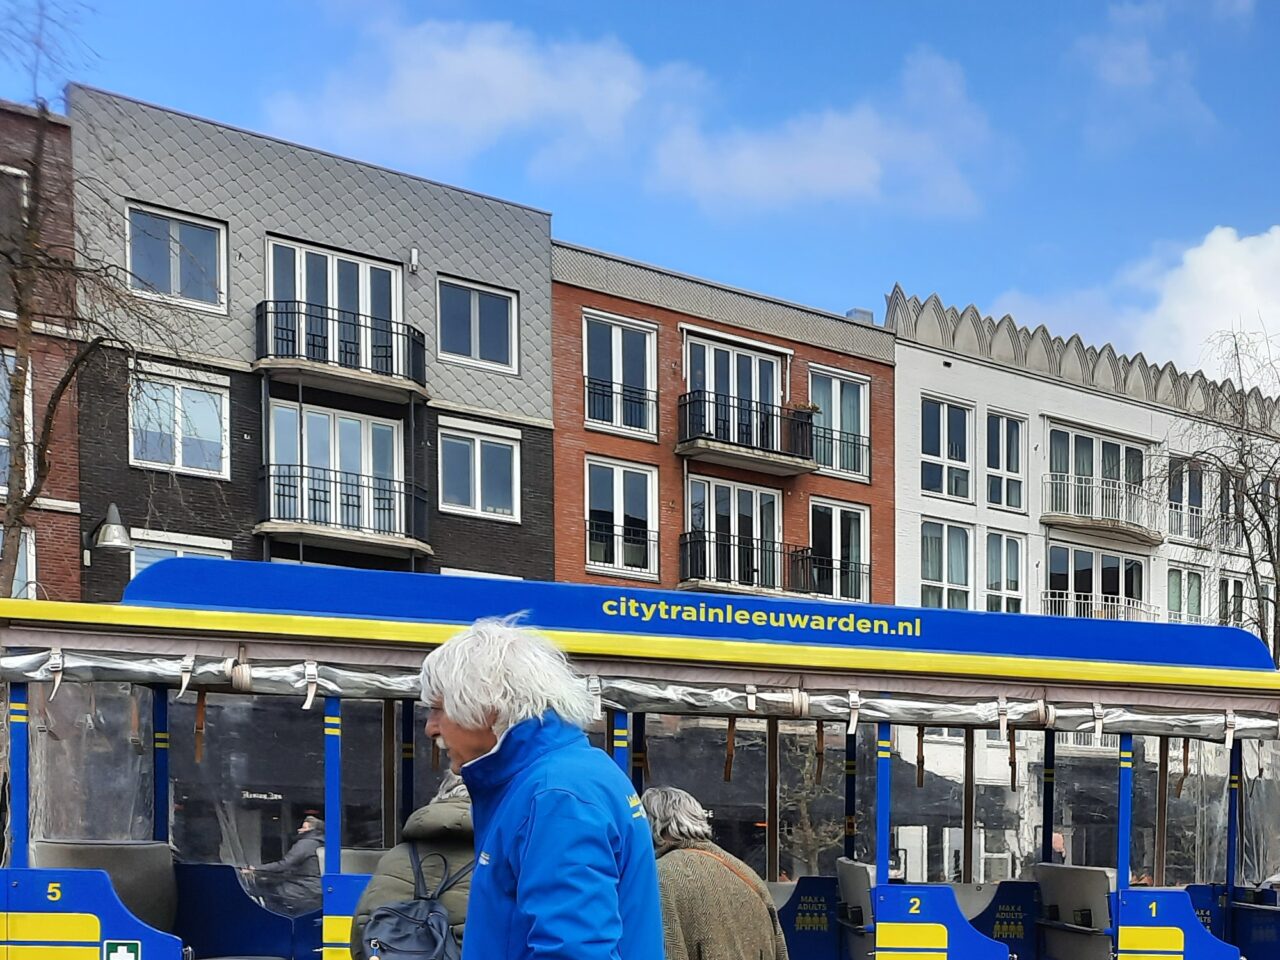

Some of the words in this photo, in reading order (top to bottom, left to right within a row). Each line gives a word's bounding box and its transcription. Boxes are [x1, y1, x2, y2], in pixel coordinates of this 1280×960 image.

[602, 597, 922, 638] citytrainleeuwarden.nl
[46, 881, 62, 902] 5
[800, 895, 819, 903] MAX
[819, 895, 825, 903] 4
[797, 903, 827, 911] ADULTS
[908, 897, 921, 914] 2
[1148, 901, 1158, 918] 1
